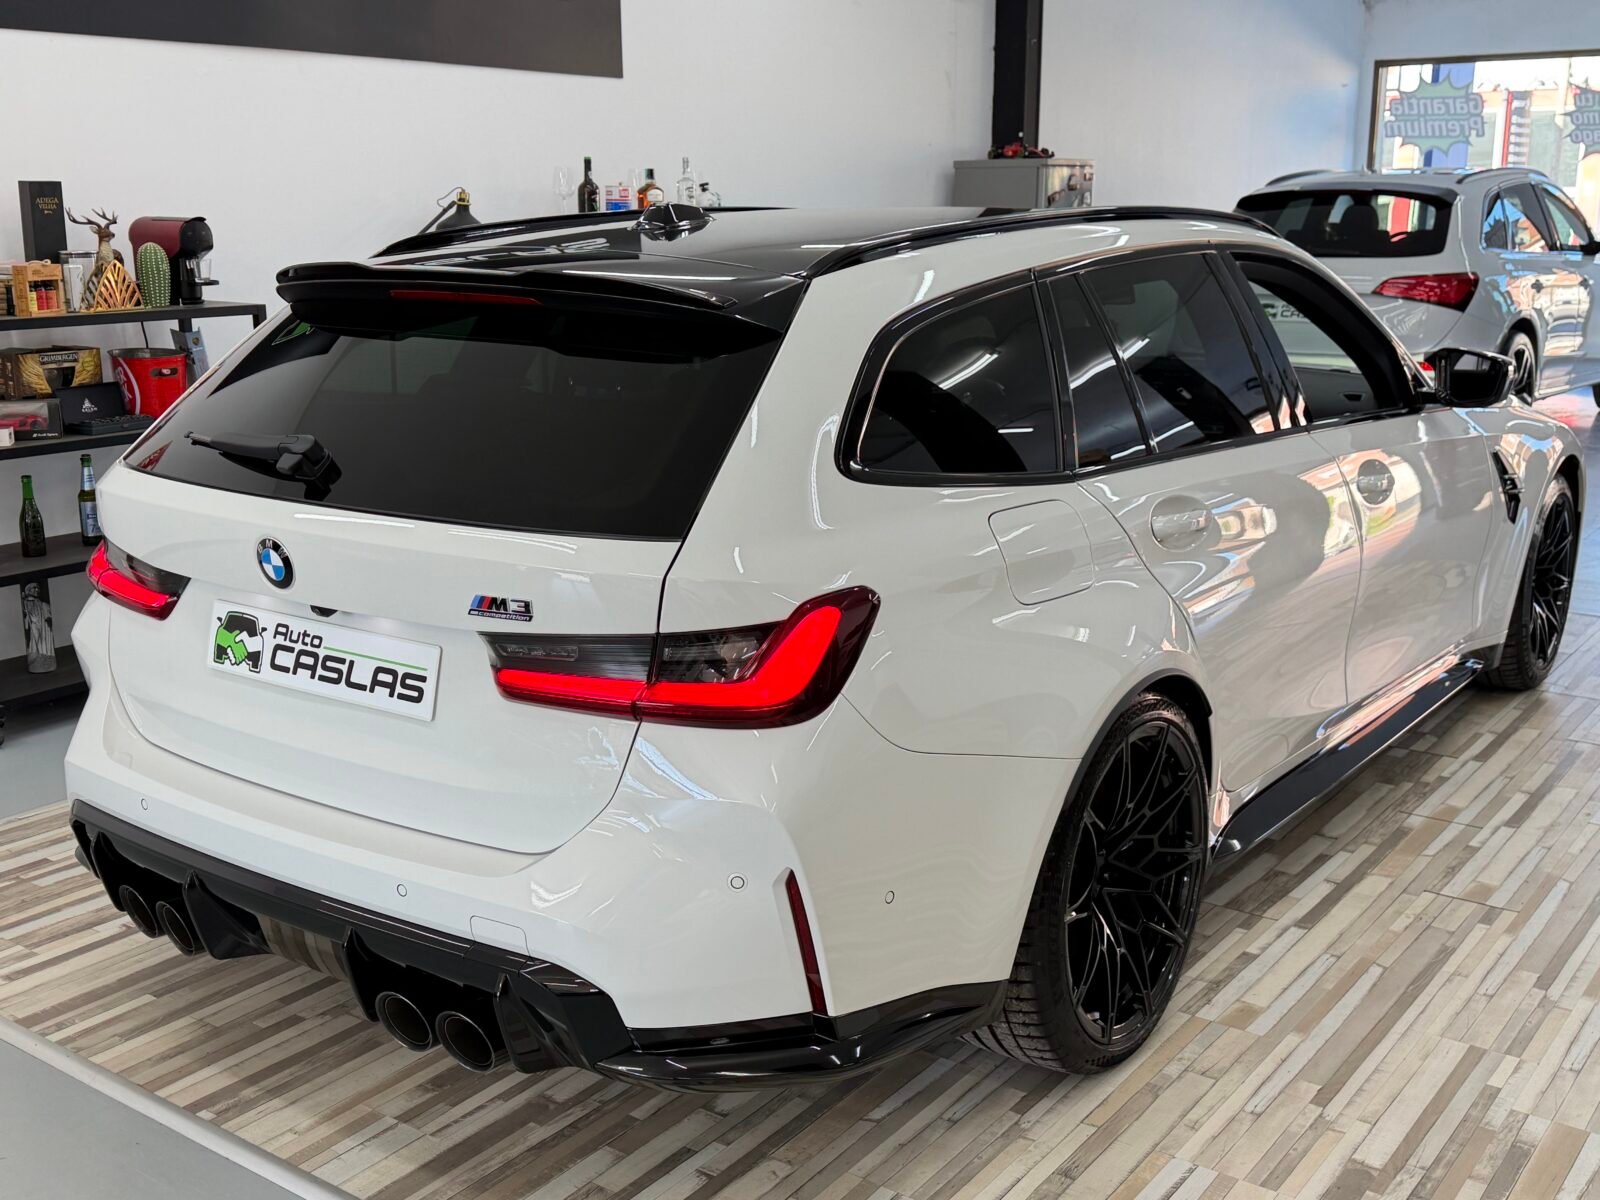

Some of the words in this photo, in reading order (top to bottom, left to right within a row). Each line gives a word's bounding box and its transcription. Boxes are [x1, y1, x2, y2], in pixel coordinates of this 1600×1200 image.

[257, 538, 287, 558] BMW
[485, 595, 533, 615] M3
[478, 611, 531, 621] competition
[273, 622, 324, 649] Auto
[269, 643, 428, 704] CASLAS
